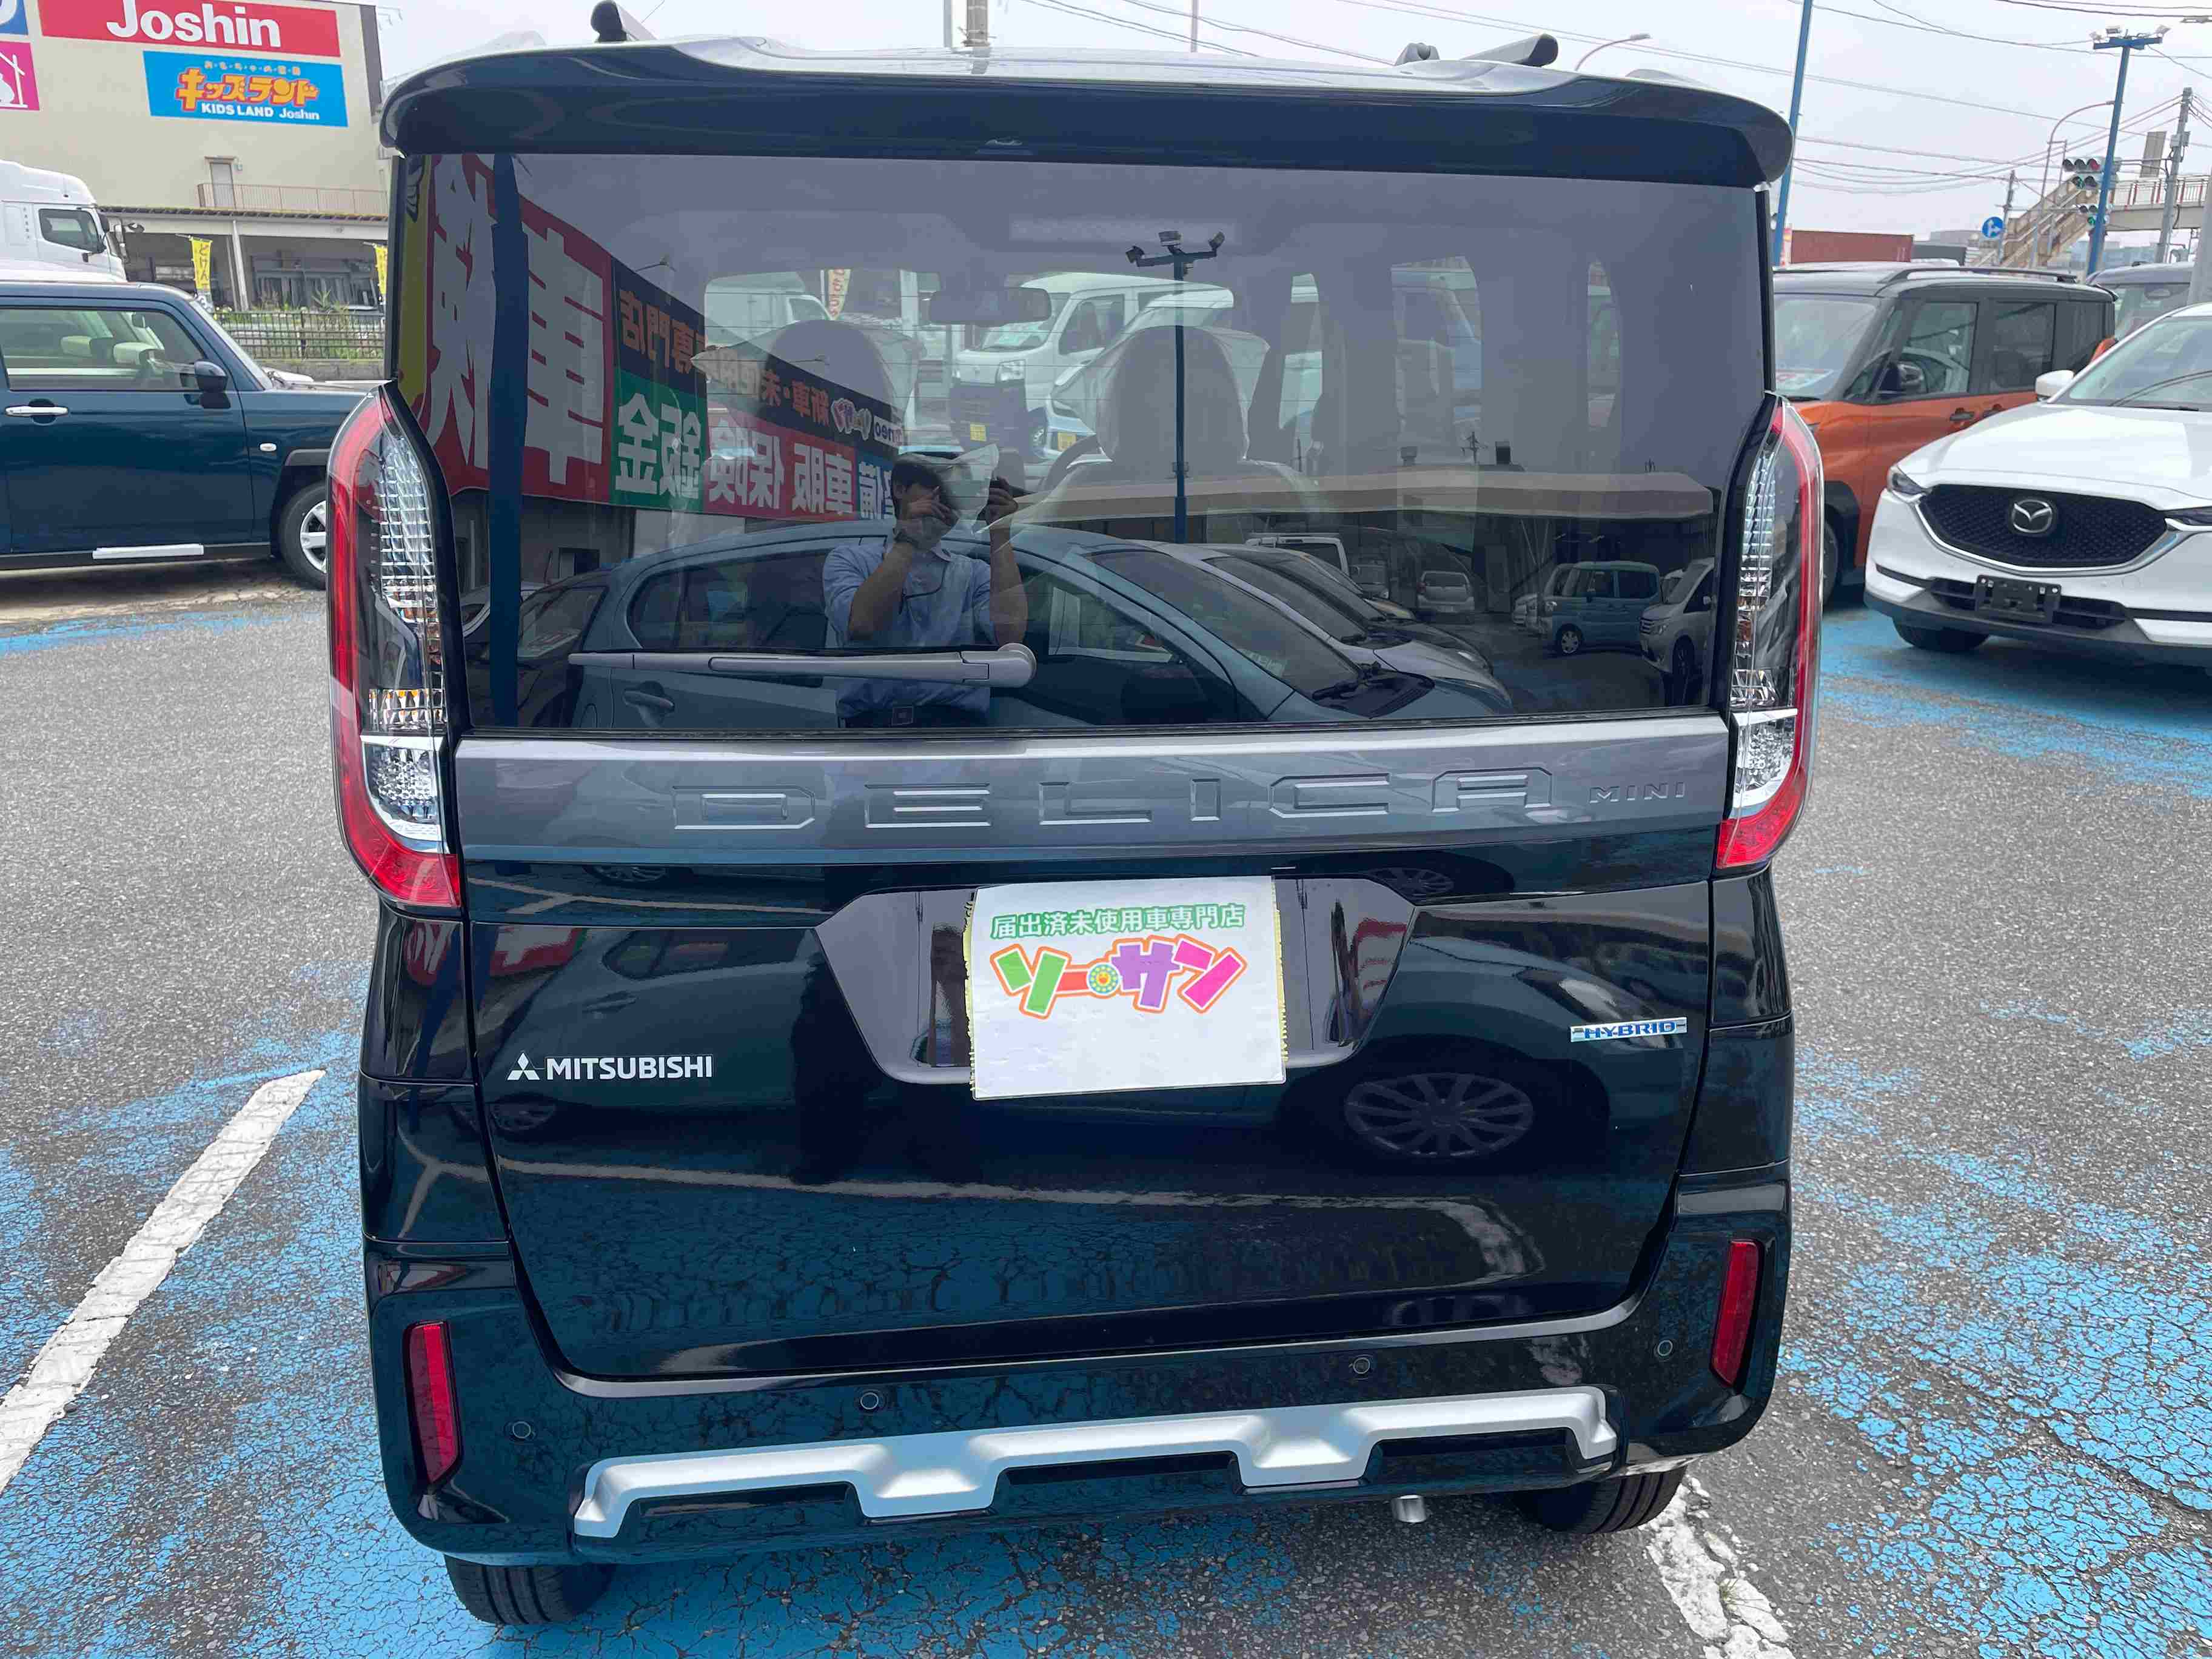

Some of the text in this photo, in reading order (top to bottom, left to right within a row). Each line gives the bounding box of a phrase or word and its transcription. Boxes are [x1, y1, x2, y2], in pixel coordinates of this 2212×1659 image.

[107, 0, 281, 47] Joshin
[176, 67, 319, 111] キッズランド
[201, 102, 320, 120] KIDS LAND Joshin
[672, 767, 1686, 830] DELICA MINI
[990, 903, 1247, 940] 届出済未使用車専門店
[990, 933, 1247, 1020] ソーサン
[1584, 1021, 1677, 1039] HYBRID
[546, 1055, 714, 1081] MITSUBISHI
